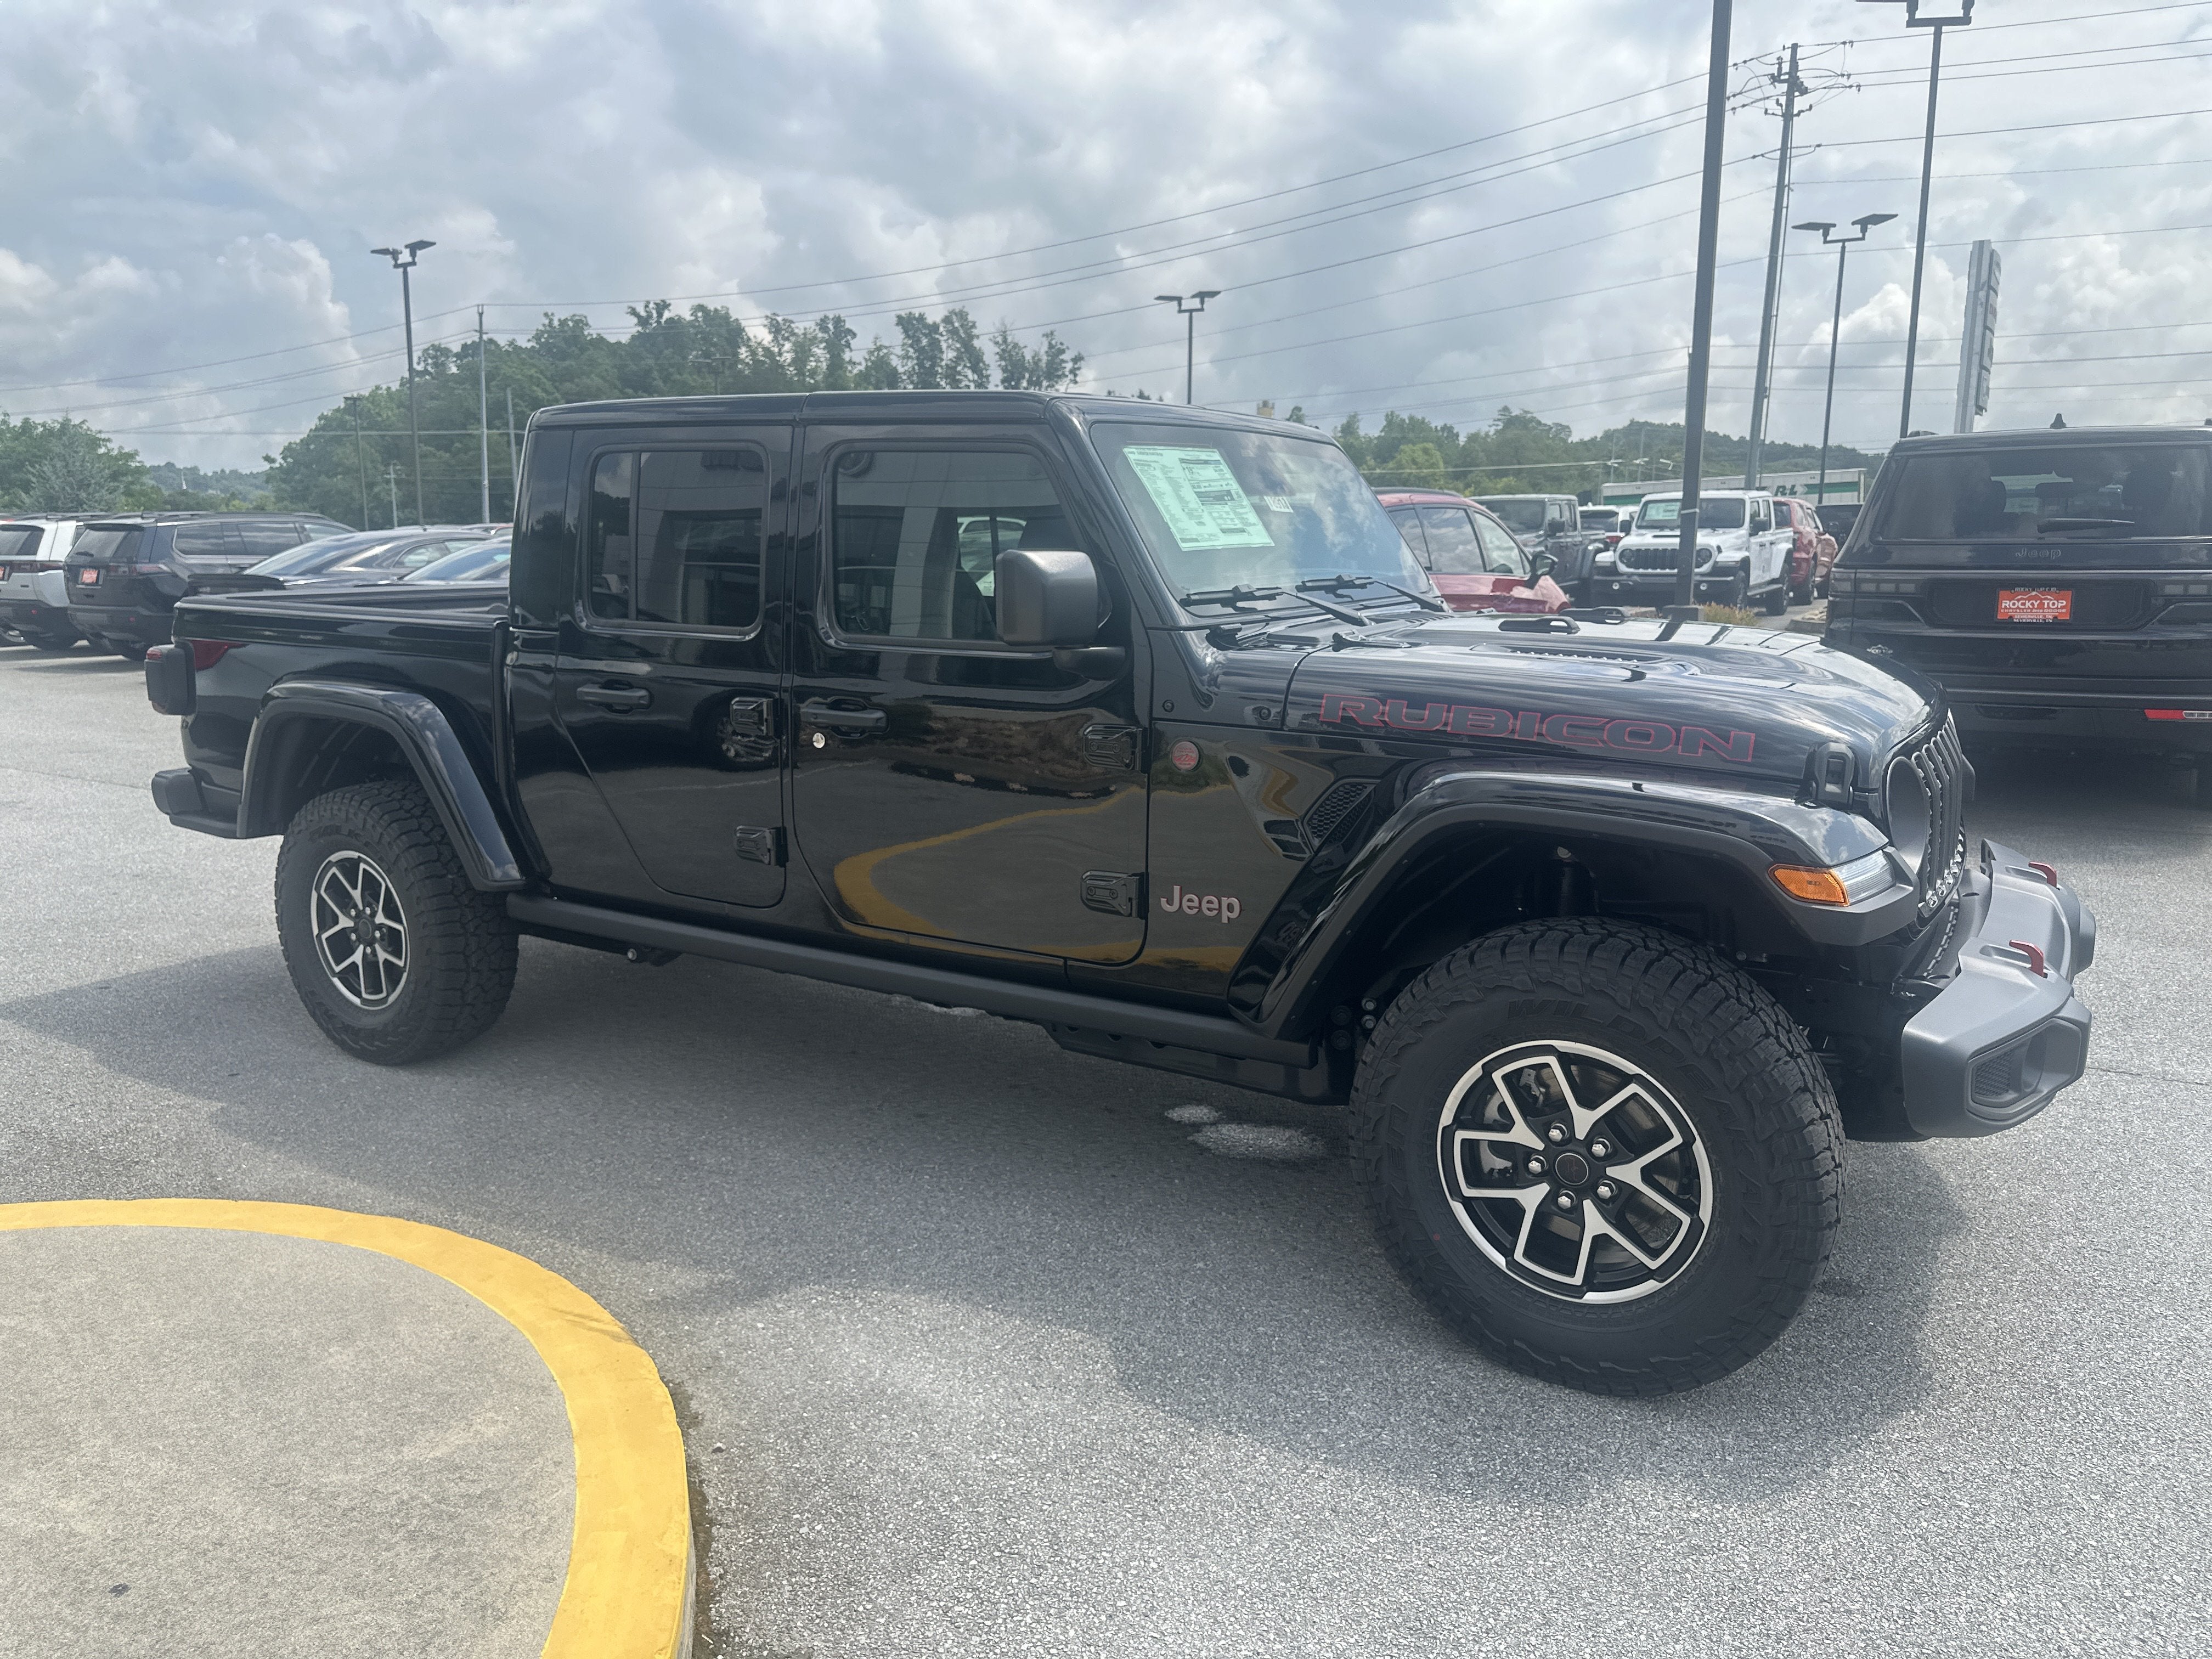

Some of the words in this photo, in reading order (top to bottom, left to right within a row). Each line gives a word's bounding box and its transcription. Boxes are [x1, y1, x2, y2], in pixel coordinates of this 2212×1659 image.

[2015, 548, 2061, 559] Jeep
[2001, 600, 2040, 608] ROCKY
[2042, 600, 2067, 608] TOP
[1319, 693, 1756, 763] RUBICON
[1160, 885, 1242, 924] Jeep
